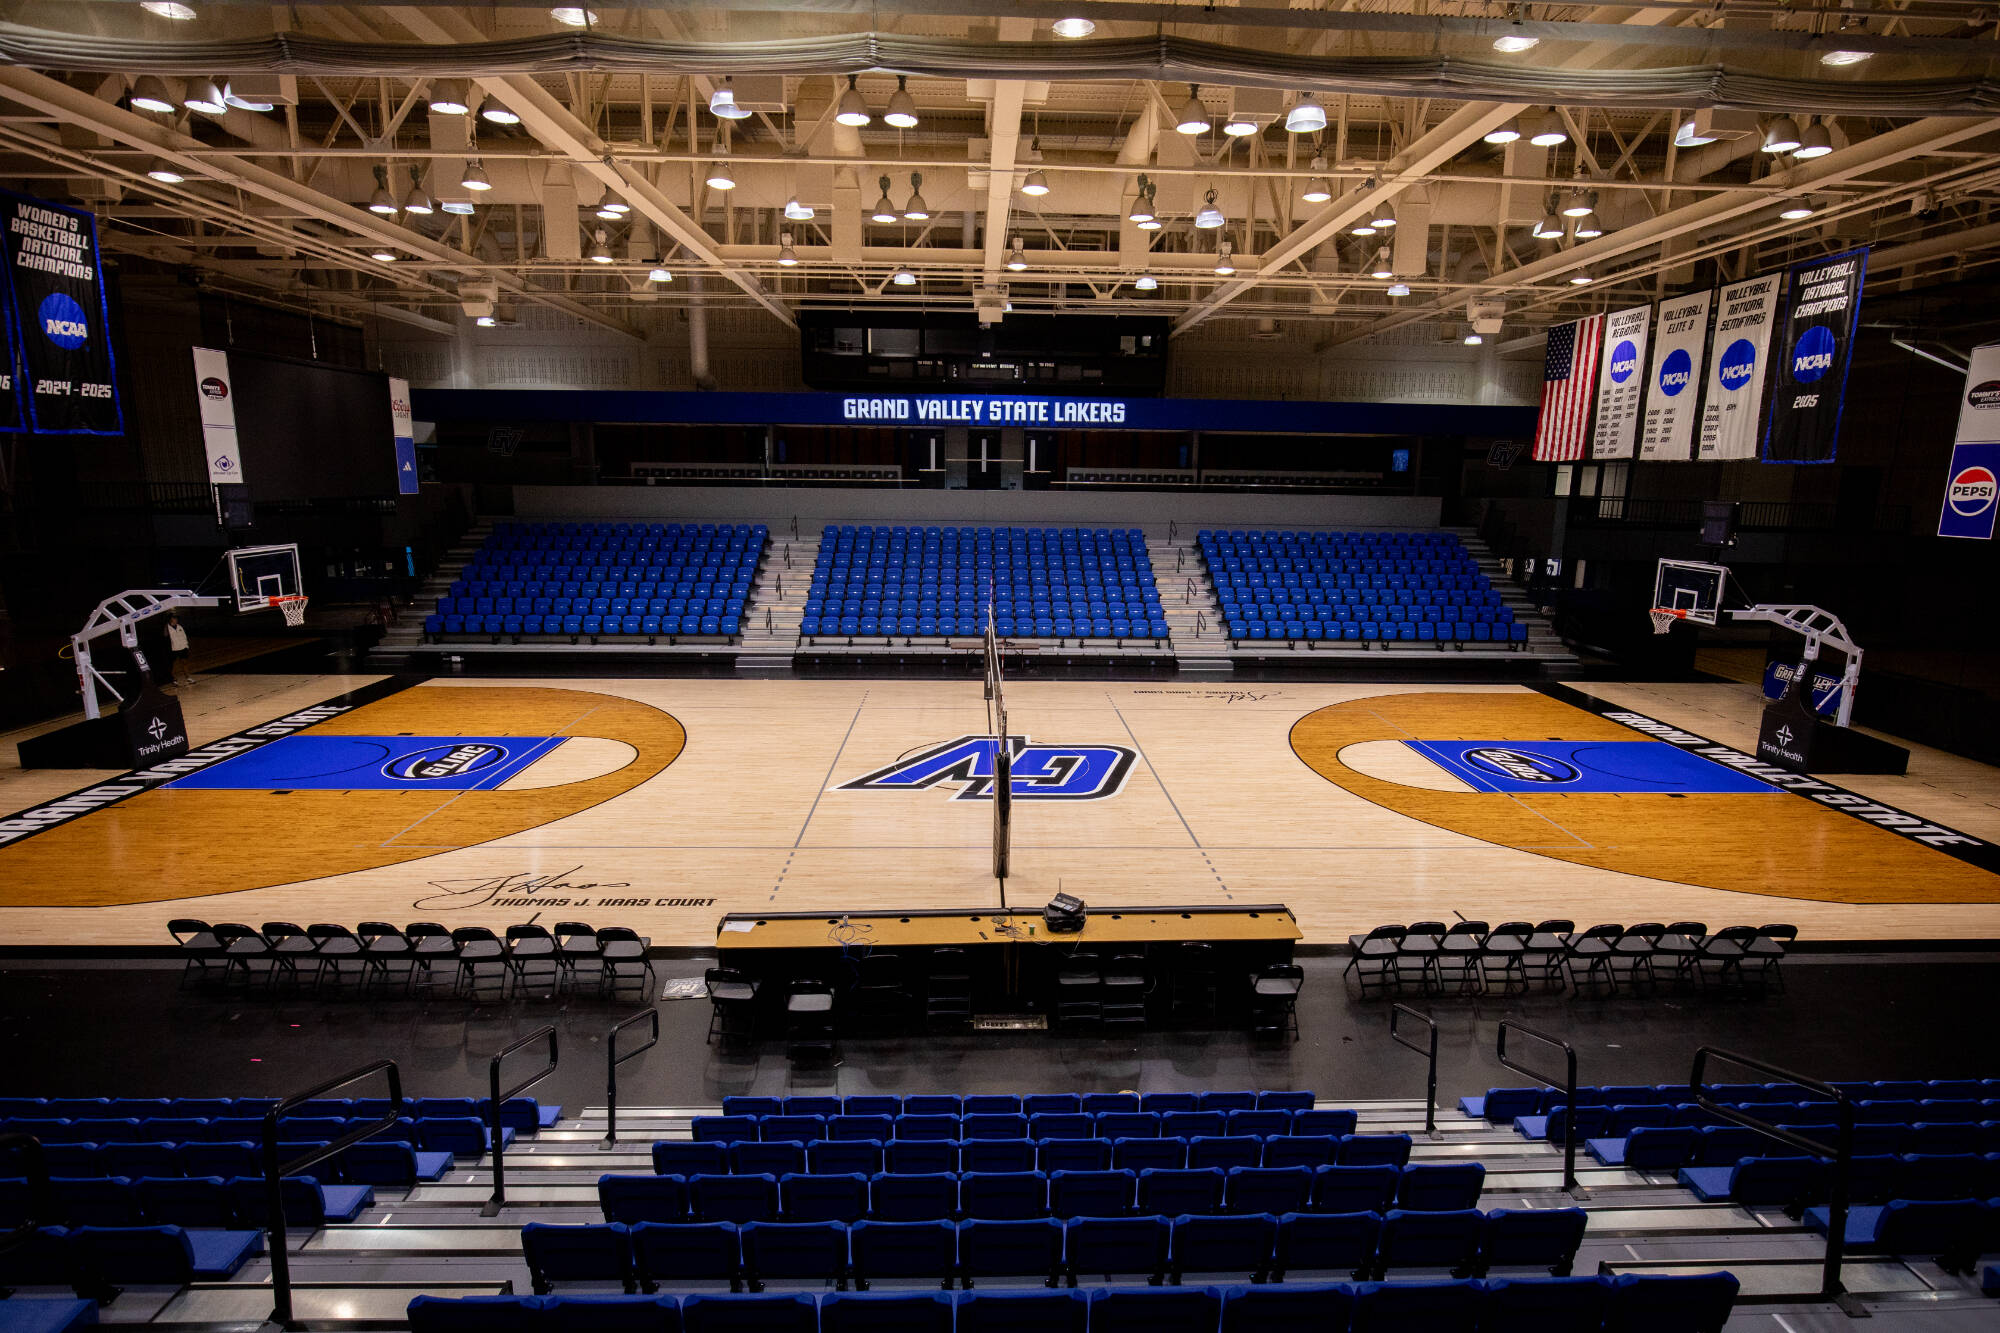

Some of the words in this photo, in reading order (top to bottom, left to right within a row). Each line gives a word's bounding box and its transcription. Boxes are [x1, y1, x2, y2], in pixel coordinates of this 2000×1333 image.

[18, 203, 79, 232] WOMEN'S
[11, 217, 89, 249] BASKETBALL
[22, 237, 83, 263] NATIONAL
[17, 251, 93, 281] CHAMPIONS
[1799, 261, 1856, 286] VOLLEYBALL
[1726, 281, 1772, 302] VOLLEYBALL
[1802, 280, 1846, 301] NATIONAL
[1663, 303, 1703, 322] VOLLEYBALL
[1727, 298, 1765, 316] NATIONAL
[1794, 296, 1848, 319] CHAMPIONS
[47, 319, 88, 338] NCAA
[1611, 311, 1646, 328] VOLLEYBALL
[1667, 320, 1688, 334] ELITE
[1720, 312, 1767, 332] SEMIFINALS
[1611, 360, 1636, 374] NCAA
[1721, 363, 1754, 381] NCAA
[1794, 353, 1832, 372] NCAA
[0, 375, 11, 391] 6
[36, 379, 72, 395] 2024
[81, 383, 113, 399] 2025
[1662, 371, 1689, 387] NCAA
[843, 398, 909, 419] GRAND
[916, 400, 983, 420] VALLEY
[989, 401, 1049, 422] STATE
[1054, 402, 1126, 423] LAKERS
[1793, 394, 1820, 409] 2005
[1953, 486, 1993, 497] PEPSI
[247, 705, 352, 736] STATE
[1601, 712, 1710, 745] GRAND
[138, 743, 161, 758] Trinity
[160, 733, 185, 749] Health
[1761, 741, 1782, 757] Trinity
[1780, 747, 1804, 763] Health
[120, 737, 266, 781] VALLEY
[420, 745, 486, 777] GLIAC
[1694, 747, 1837, 791] VALLEY
[1810, 793, 1983, 847] STATE
[491, 898, 568, 907] THOMAS
[574, 898, 591, 907] J.
[599, 898, 650, 907] HAAS
[655, 898, 718, 907] COURT
